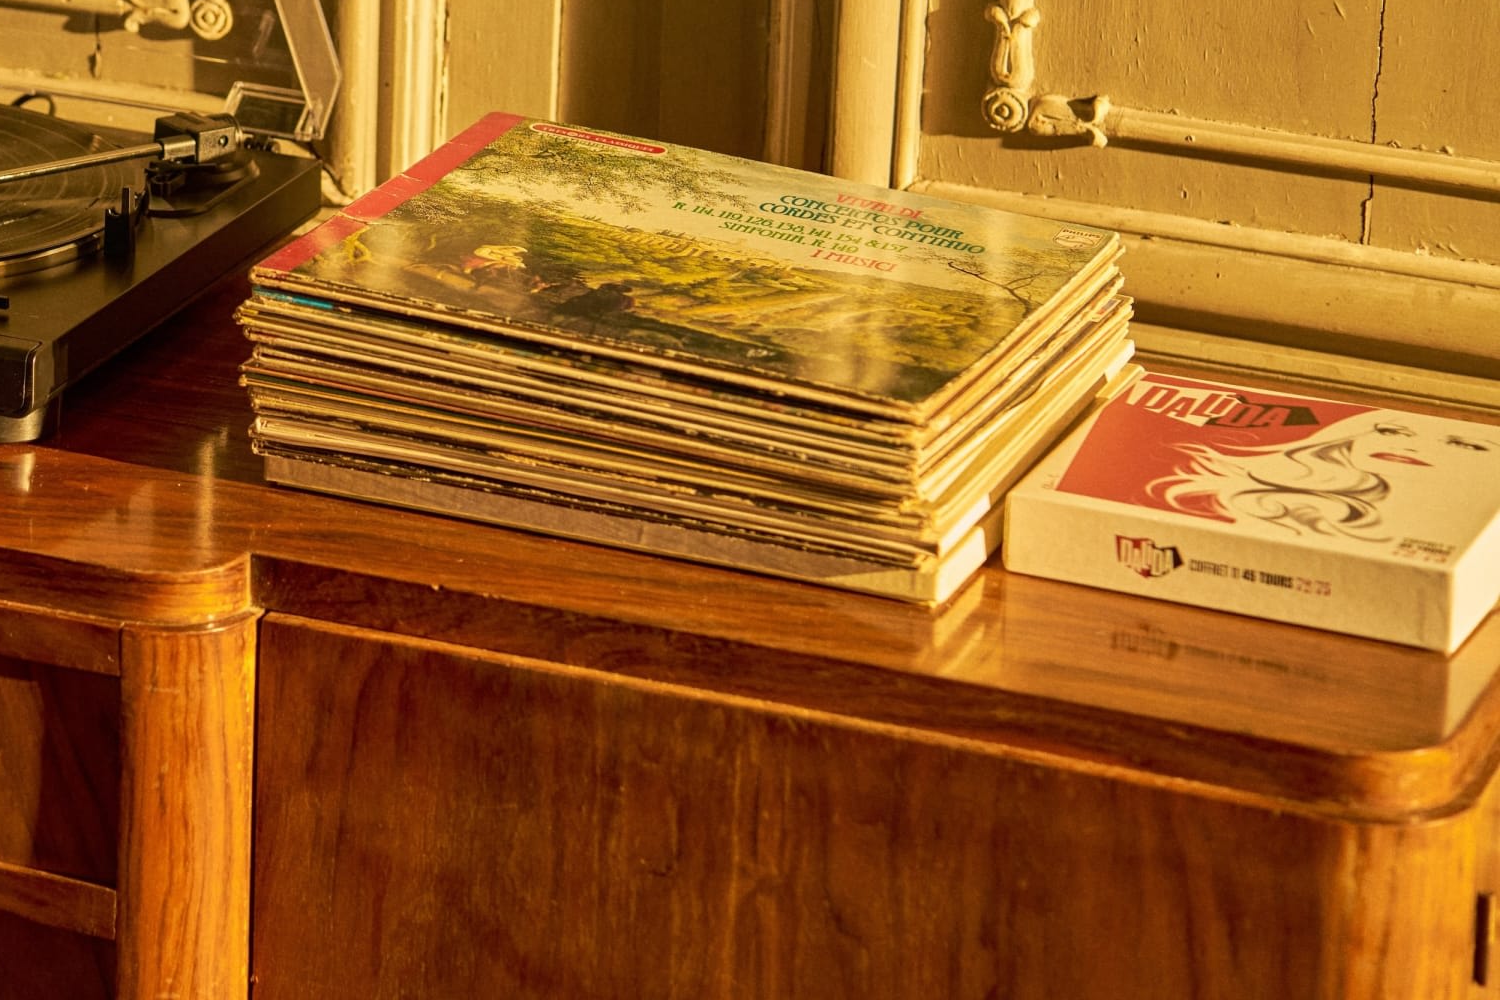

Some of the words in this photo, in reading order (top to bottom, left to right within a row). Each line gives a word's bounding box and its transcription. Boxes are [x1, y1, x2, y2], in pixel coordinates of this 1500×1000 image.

[671, 201, 687, 211] R.
[779, 194, 902, 227] CONCERTOS
[903, 219, 965, 239] POUR
[836, 192, 925, 220] VIVALDI
[758, 202, 841, 225] CORDES
[841, 217, 873, 231] ET
[873, 225, 986, 255] CONTINUO
[821, 251, 899, 273] MUSICI
[1188, 558, 1230, 580] COFFRET
[1258, 570, 1294, 589] TOURS
